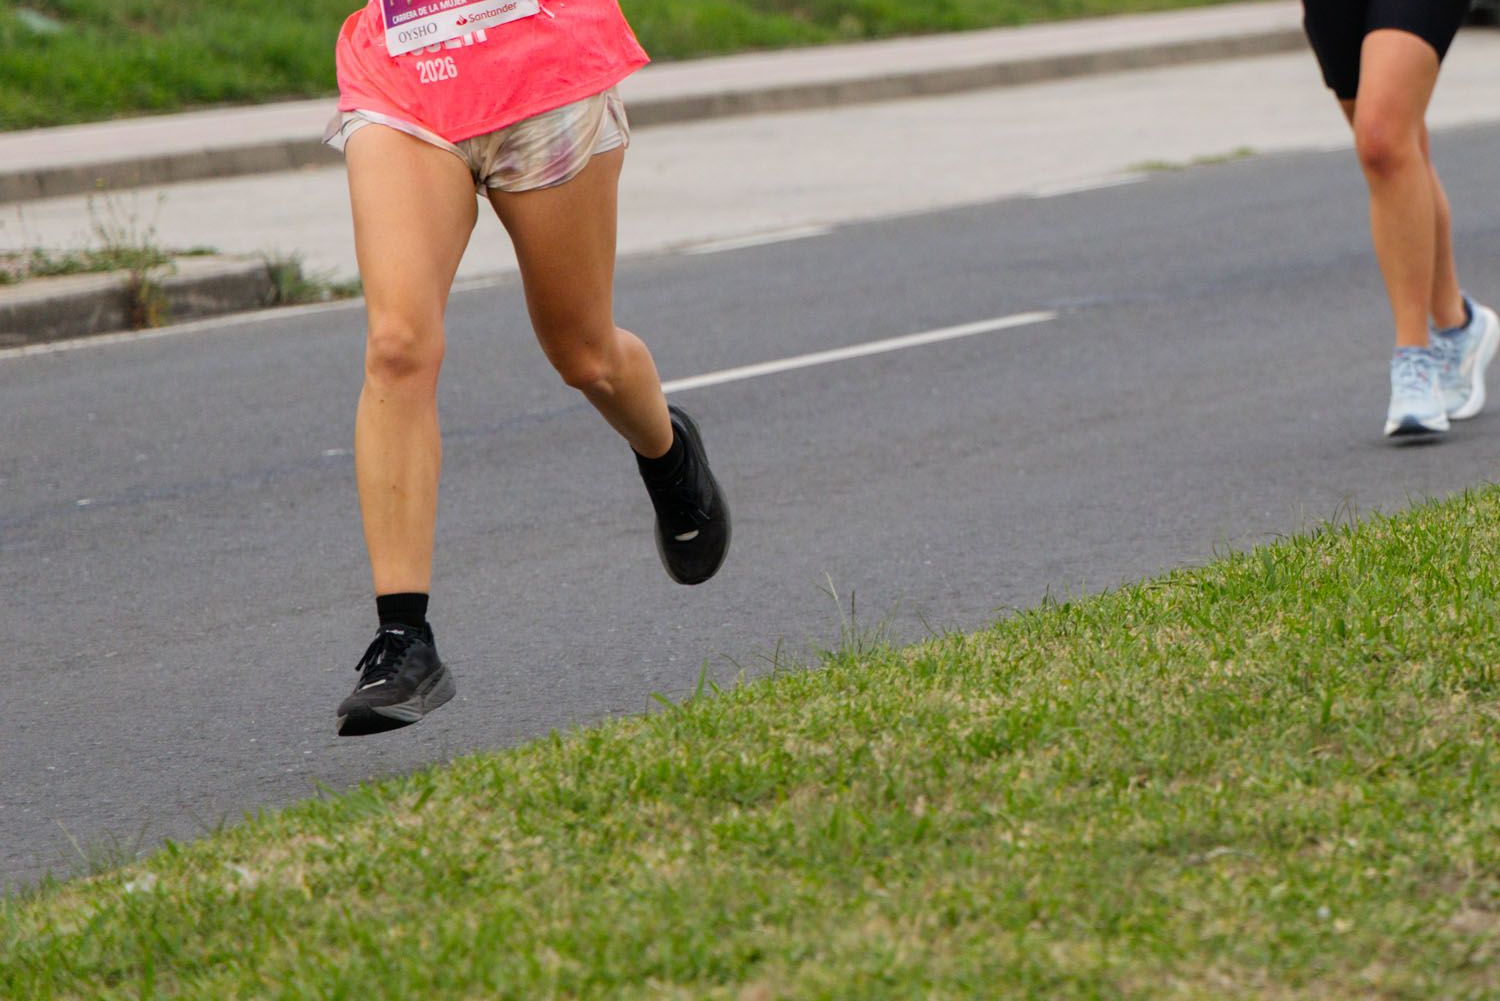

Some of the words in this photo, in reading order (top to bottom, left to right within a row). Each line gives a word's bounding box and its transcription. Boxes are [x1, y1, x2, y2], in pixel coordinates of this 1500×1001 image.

[398, 22, 438, 43] OYSHO
[468, 2, 518, 23] Santander
[418, 6, 428, 16] DE
[428, 3, 439, 13] LA
[416, 56, 458, 84] 2026
